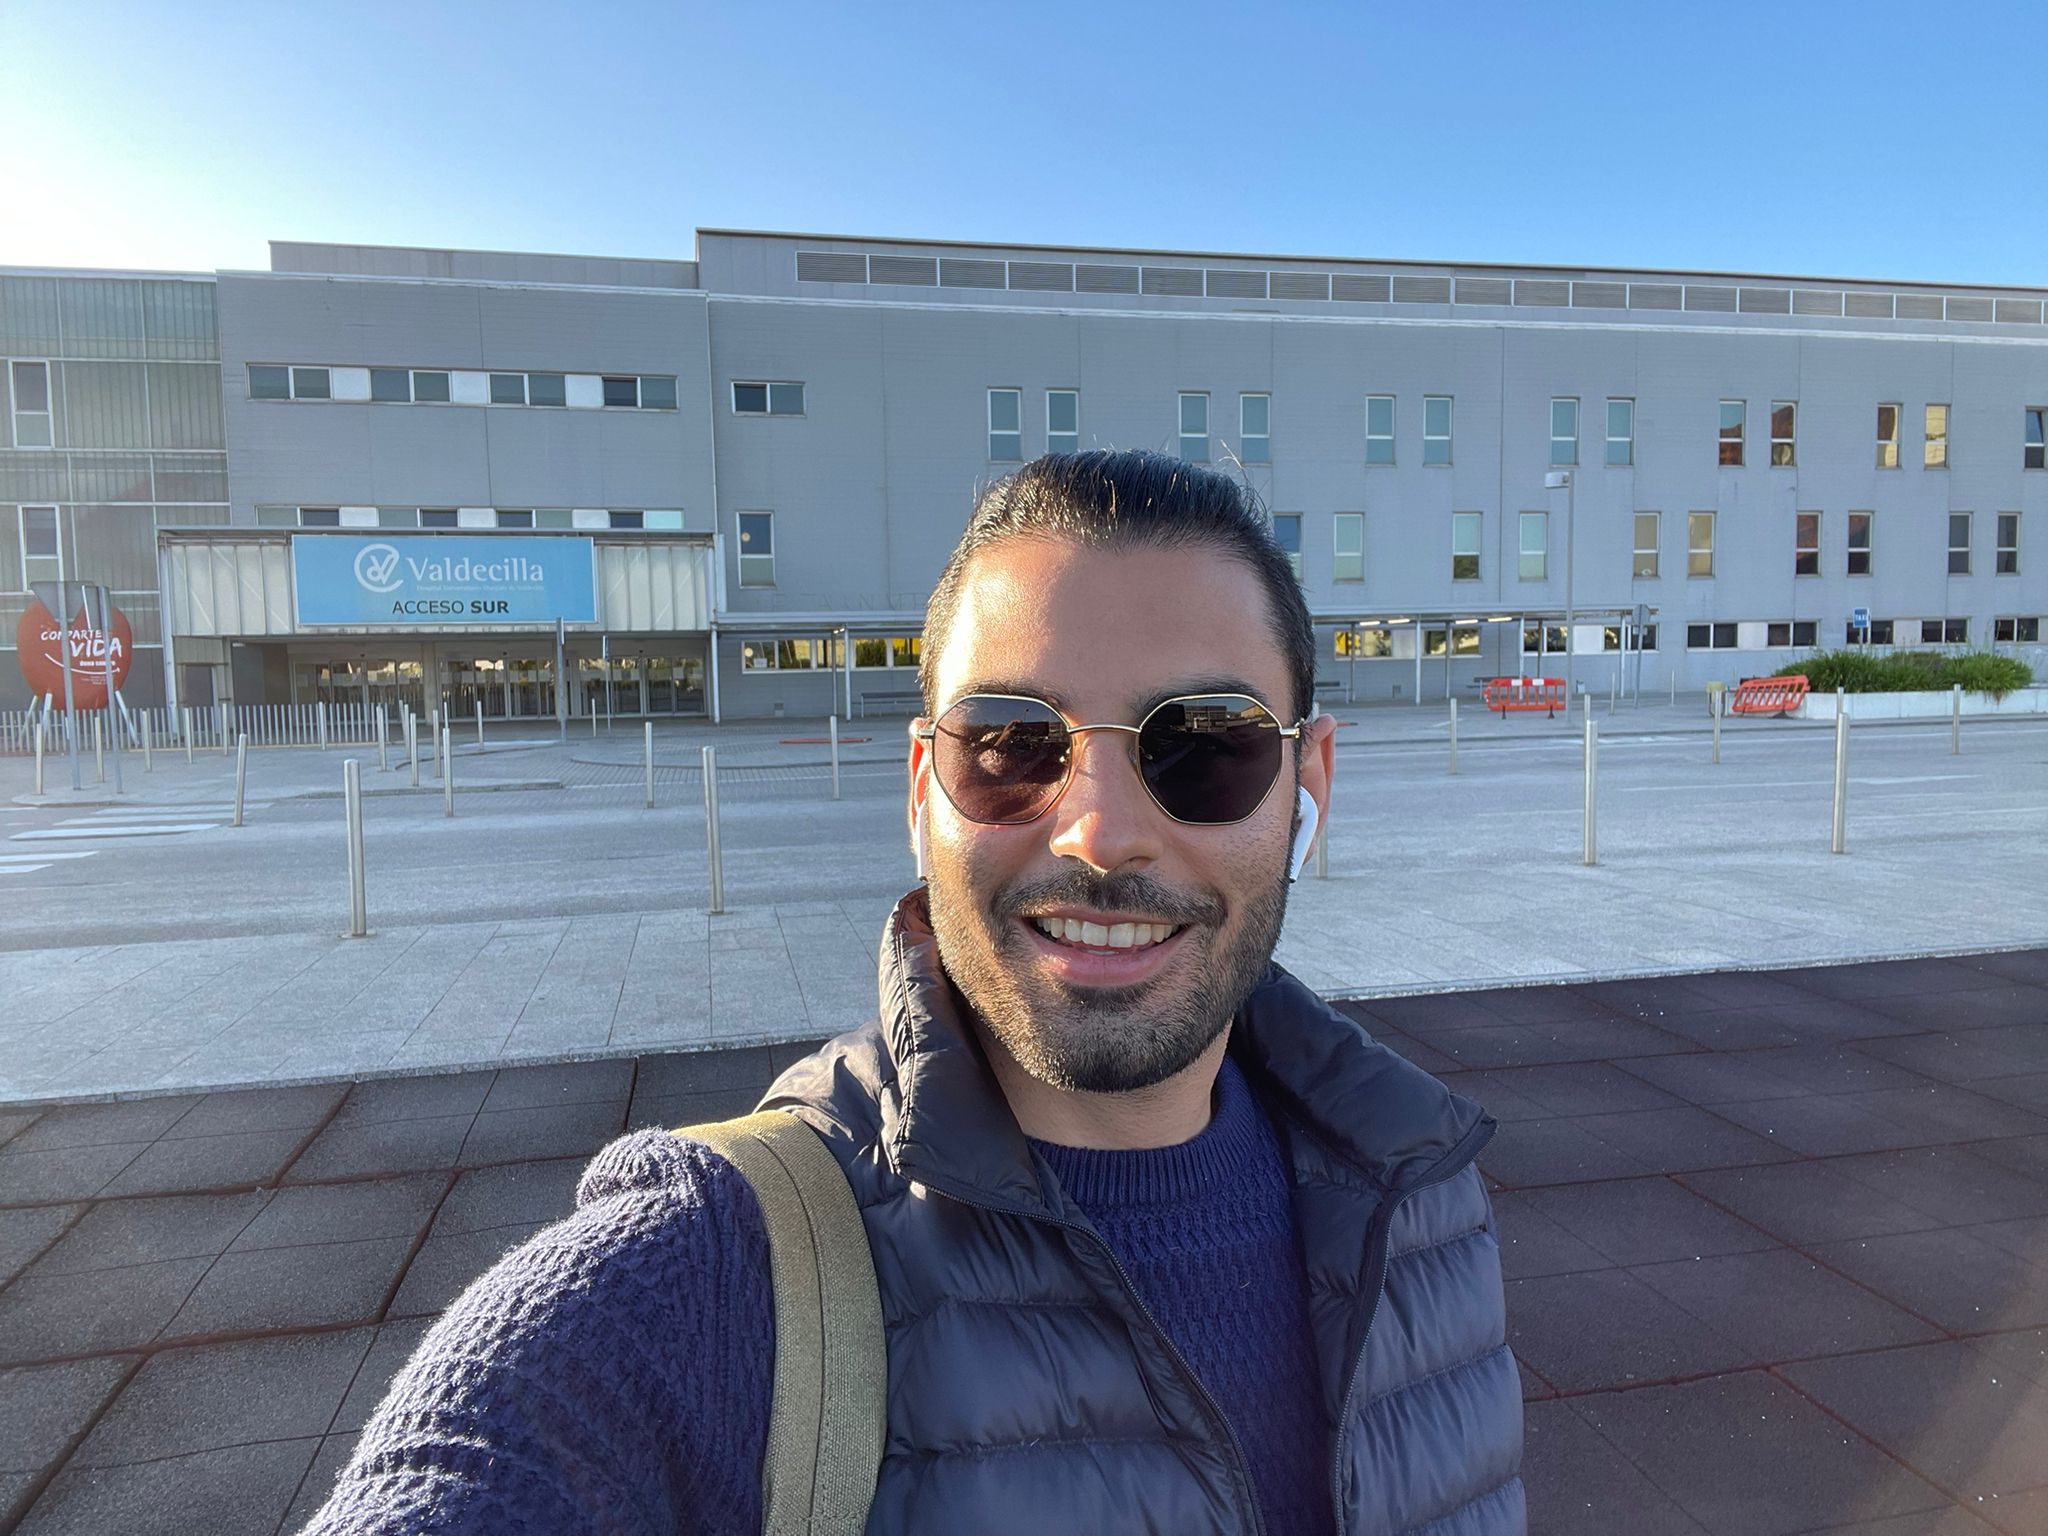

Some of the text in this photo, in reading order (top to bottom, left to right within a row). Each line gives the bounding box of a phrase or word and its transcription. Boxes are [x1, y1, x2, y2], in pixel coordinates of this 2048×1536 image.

[405, 556, 544, 582] Valdecilla
[392, 600, 510, 615] ACCESO SUR
[69, 637, 122, 658] VIDA
